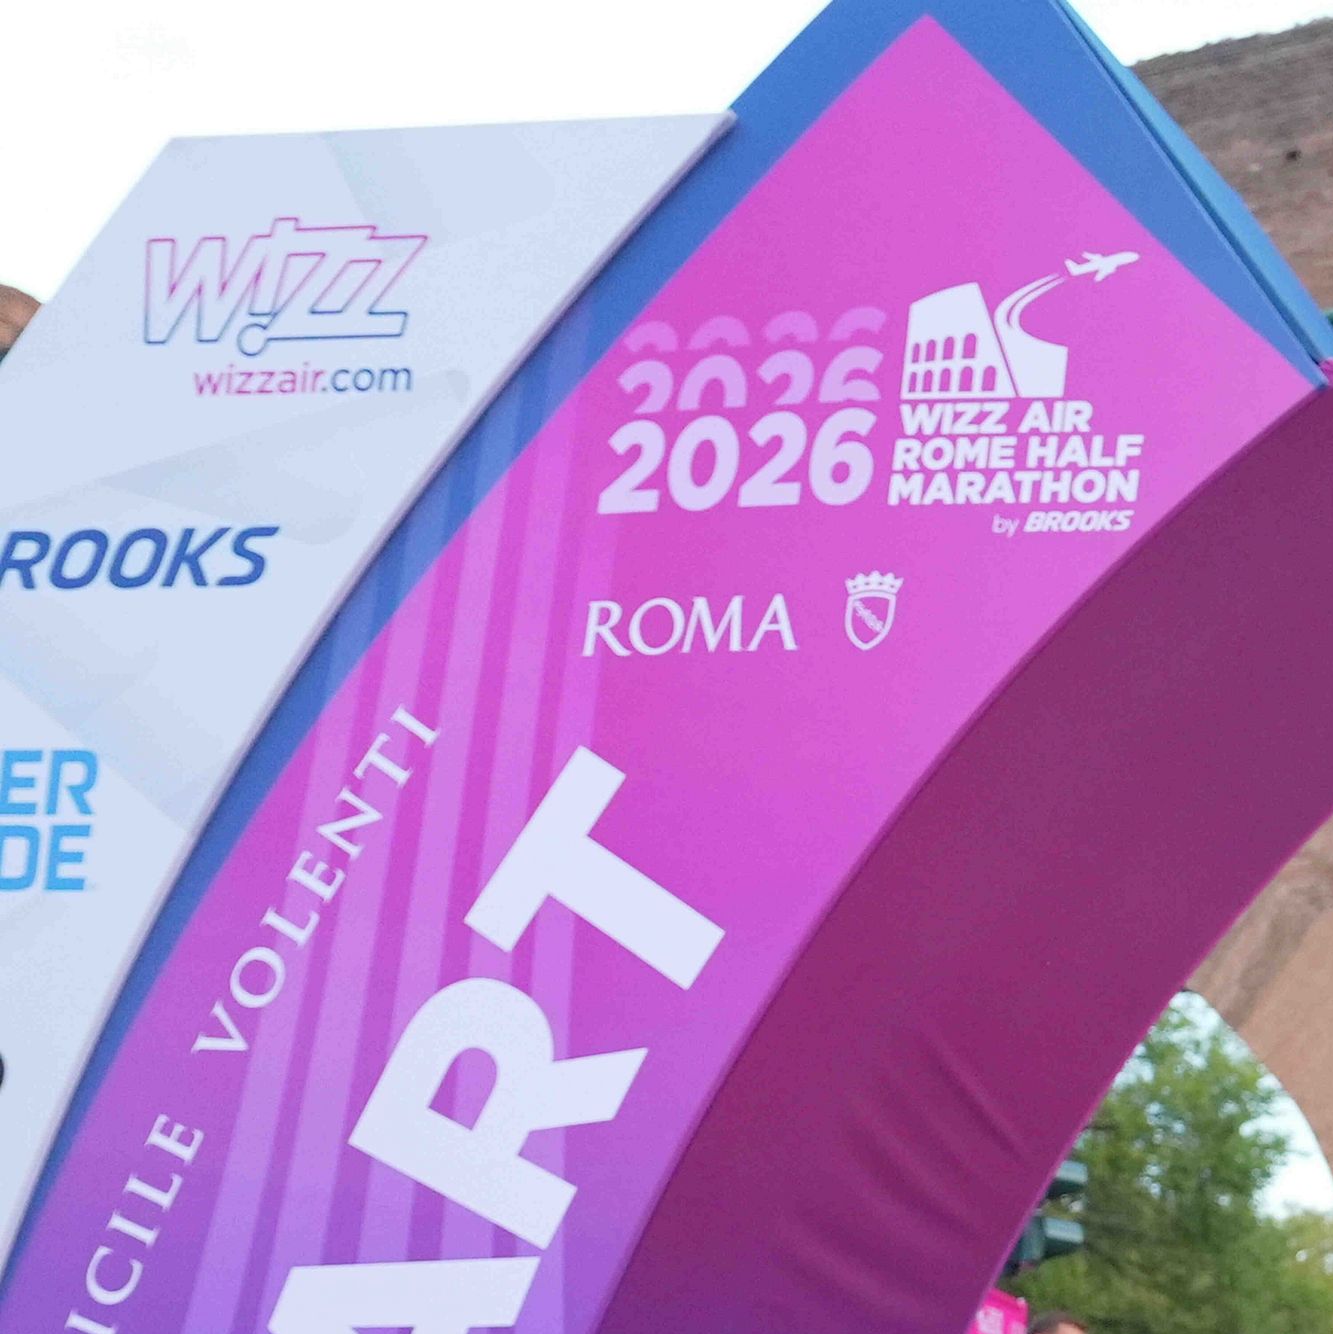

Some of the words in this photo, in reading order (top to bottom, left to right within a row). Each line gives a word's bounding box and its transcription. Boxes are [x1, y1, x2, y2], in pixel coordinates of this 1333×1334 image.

[193, 361, 414, 397] wizzair.com
[899, 401, 1011, 436] WIZZ
[1017, 399, 1094, 433] AIR
[597, 406, 878, 515] 2026
[891, 435, 1018, 471] ROME
[1025, 433, 1145, 468] HALF
[887, 468, 1141, 506] MARATHON
[991, 514, 1020, 538] by
[1023, 509, 1135, 533] BROOKS
[581, 594, 798, 657] ROMA
[191, 704, 442, 1055] VOLENTI
